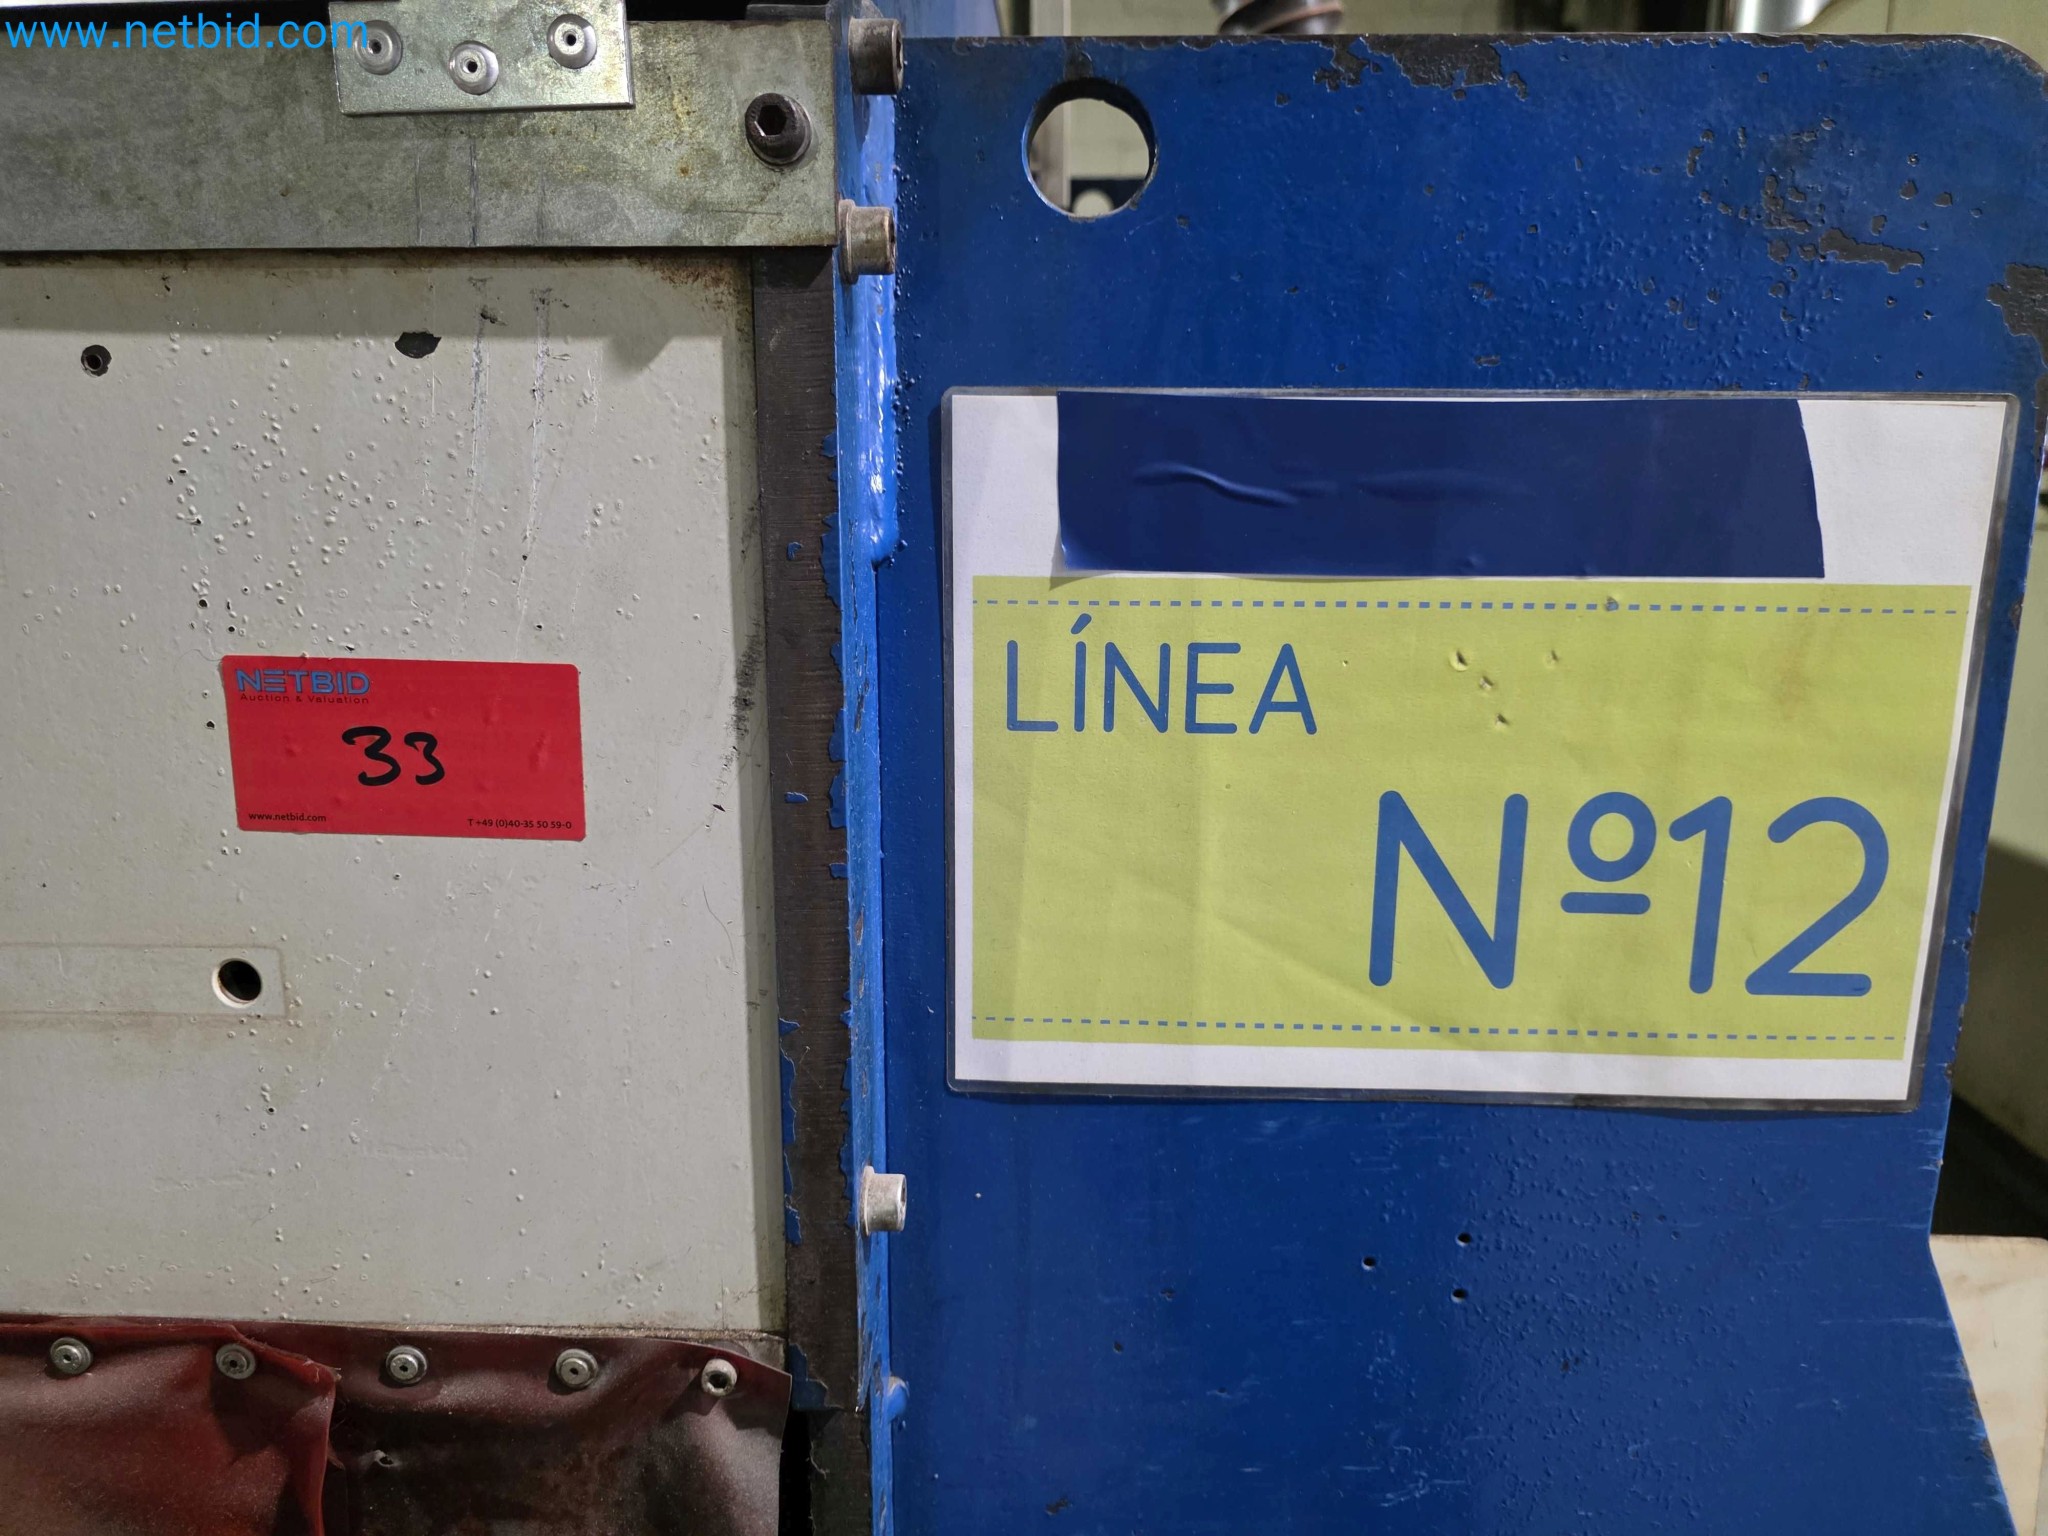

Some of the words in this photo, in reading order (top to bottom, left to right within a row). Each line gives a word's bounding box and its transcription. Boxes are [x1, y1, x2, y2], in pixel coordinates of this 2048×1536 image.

[235, 669, 370, 695] NETBID
[1006, 612, 1318, 735] LÍNEA
[240, 693, 290, 702] Auction
[307, 695, 370, 704] Valuation
[341, 725, 446, 787] 33
[248, 812, 327, 822] www.netbid.com
[467, 818, 474, 827] T
[476, 819, 493, 827] +49
[495, 819, 534, 829] (0)40-35
[537, 821, 549, 829] 50
[551, 821, 572, 830] 59-0
